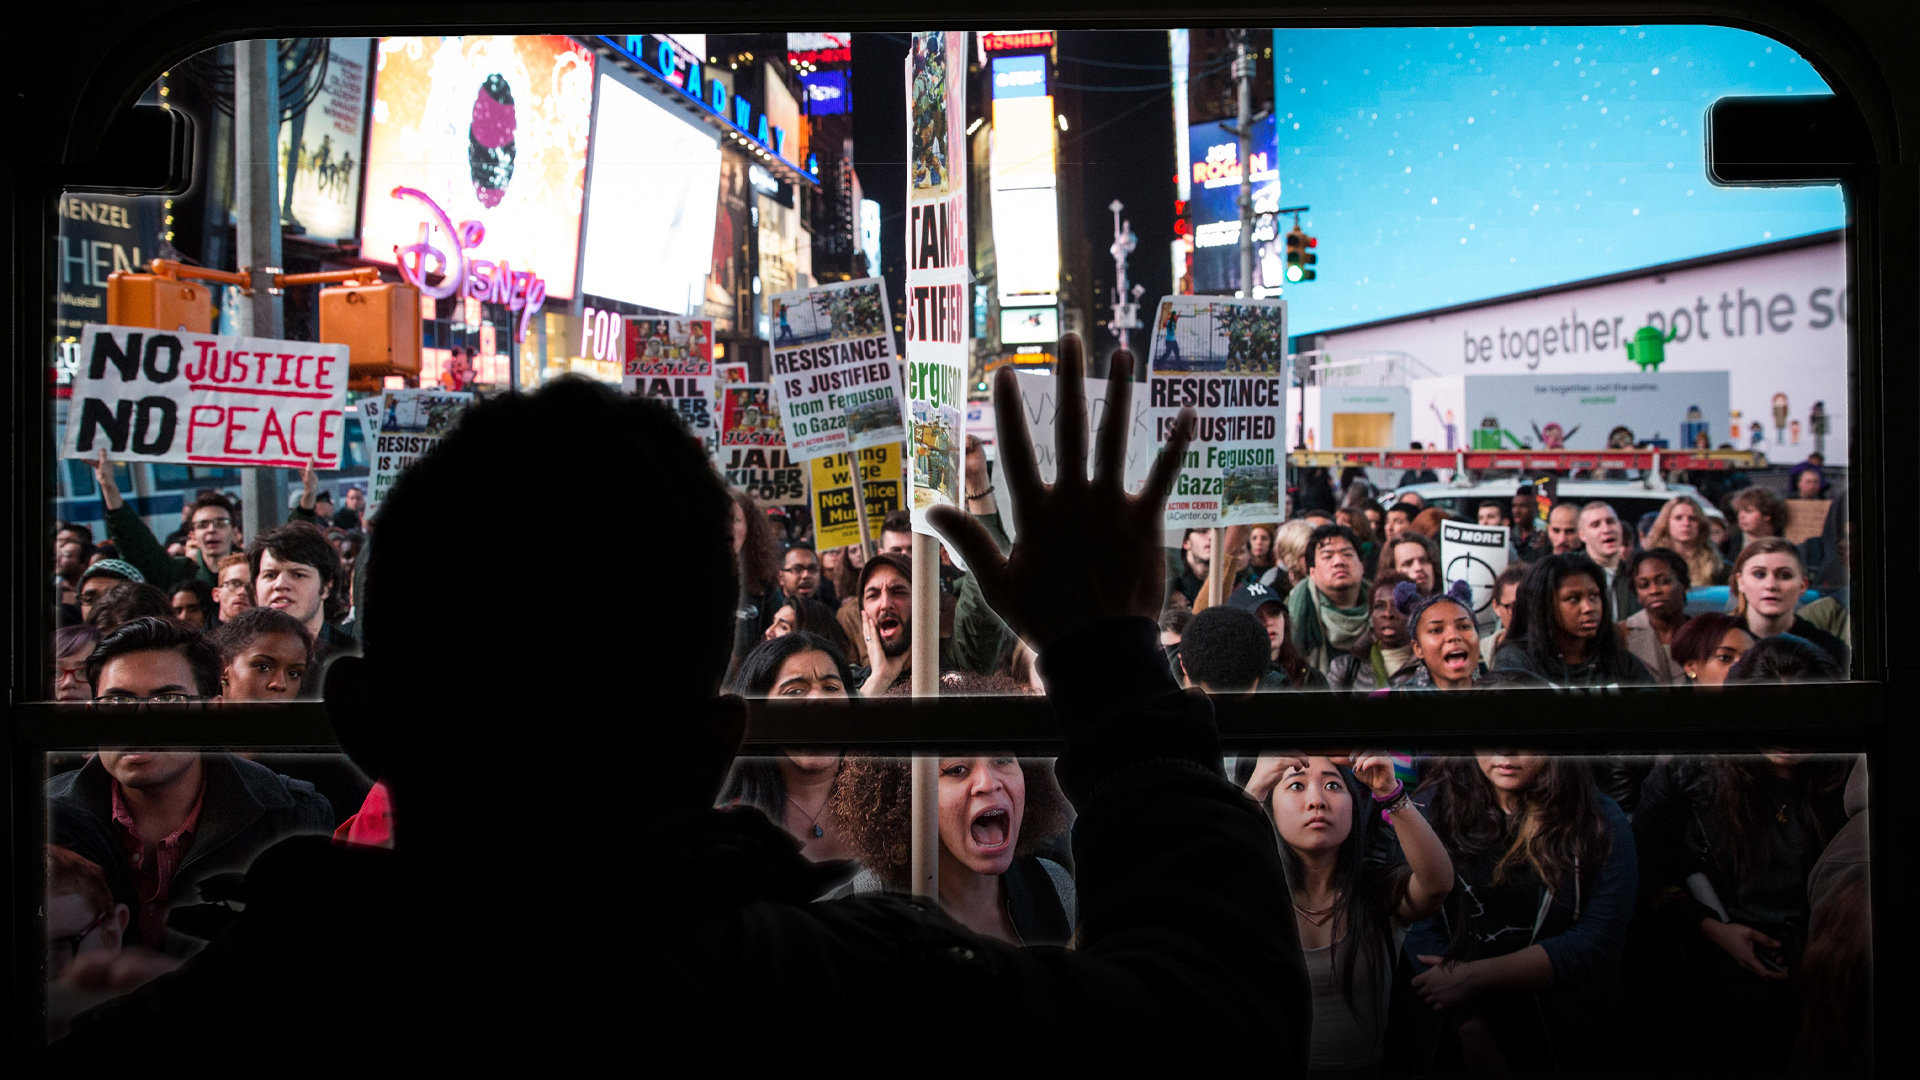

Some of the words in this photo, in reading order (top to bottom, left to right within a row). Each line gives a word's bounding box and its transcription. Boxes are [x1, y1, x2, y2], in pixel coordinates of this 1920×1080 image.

[984, 32, 1053, 50] TOSHIBA
[1193, 152, 1267, 184] ROGN
[1464, 330, 1493, 363] be
[1647, 295, 1708, 343] not
[1719, 288, 1796, 334] the
[1808, 286, 1847, 329] s
[89, 332, 183, 384] NO
[185, 341, 336, 389] JUSTICE
[774, 337, 889, 375] RESISTANCE
[630, 378, 704, 397] JAIL
[785, 379, 802, 398] IS
[808, 362, 891, 394] JUSTIFIED
[789, 398, 824, 418] from
[828, 386, 893, 412] Ferguson
[1151, 378, 1280, 407] RESISTANCE
[365, 402, 378, 416] IS
[76, 396, 179, 456] NO
[186, 405, 342, 459] PEACE
[793, 420, 807, 438] to
[810, 413, 847, 433] Gaza
[378, 456, 391, 470] IS
[823, 456, 834, 468] a
[838, 448, 887, 465] liing
[1207, 447, 1275, 469] Ferguson
[725, 469, 802, 486] KILLER
[832, 464, 881, 484] wge
[1177, 474, 1223, 495] Gaza
[822, 491, 849, 508] Not
[862, 484, 896, 498] olice
[1192, 501, 1218, 510] CENTER
[830, 500, 888, 522] Murer!
[1446, 527, 1460, 540] NO
[1461, 530, 1502, 544] MORE
